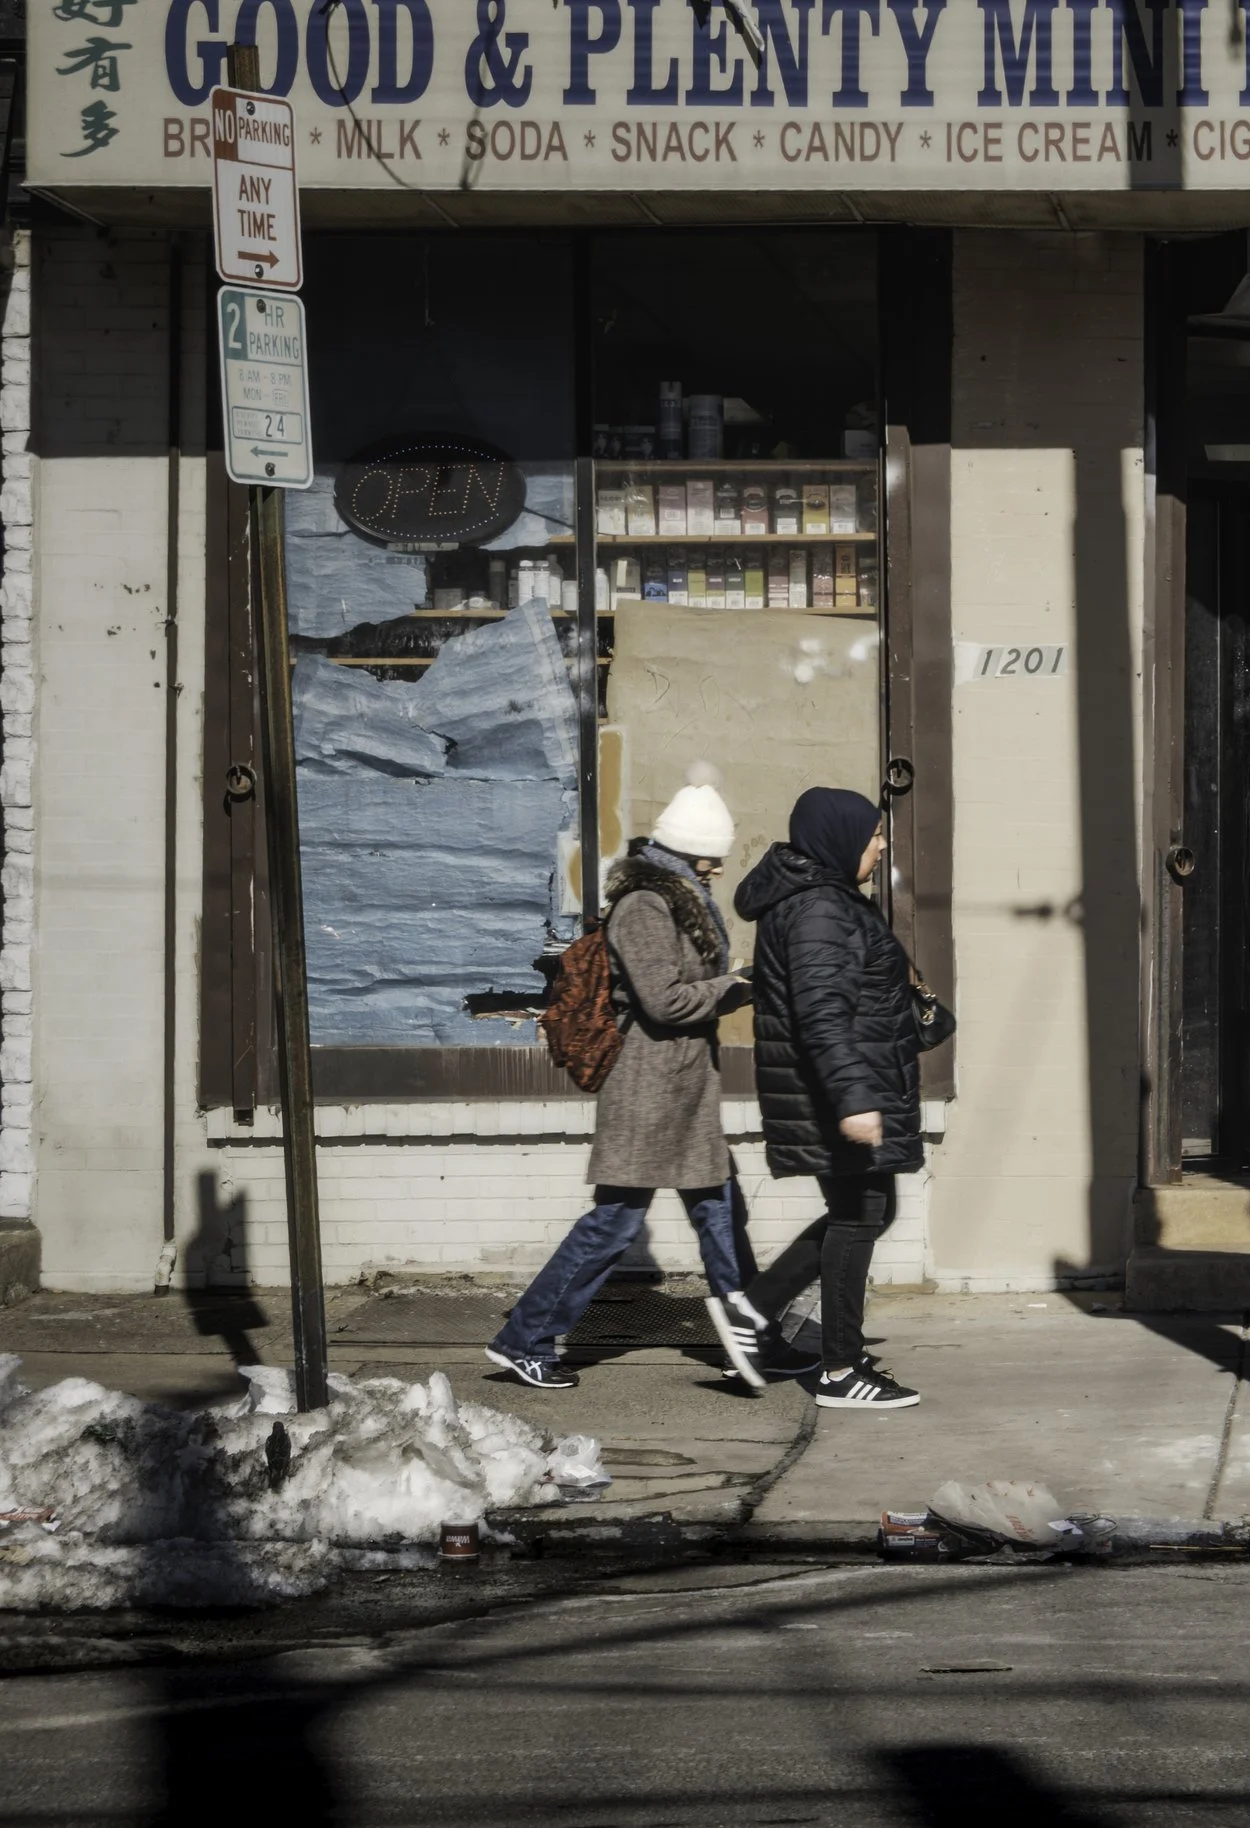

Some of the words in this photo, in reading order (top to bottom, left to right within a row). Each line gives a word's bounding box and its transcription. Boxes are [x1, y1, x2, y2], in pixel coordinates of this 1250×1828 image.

[165, 0, 434, 107] GOOD
[464, 0, 533, 108] &
[563, 0, 947, 107] PLENTY
[977, 0, 1209, 107] MINI
[215, 108, 235, 144] NO
[239, 116, 290, 147] PARKING
[337, 119, 423, 160] MILK
[465, 119, 569, 161] SODA
[611, 121, 738, 162] SNACK
[780, 121, 904, 162] CANDY
[946, 121, 1003, 162] ICE
[1017, 121, 1152, 162] CREAM
[239, 174, 272, 205] ANY
[237, 209, 277, 241] TIME
[226, 302, 242, 349] 2
[264, 305, 285, 329] HR
[249, 332, 299, 360] PARKING
[353, 463, 504, 520] OPEN
[981, 647, 1064, 676] 1201
